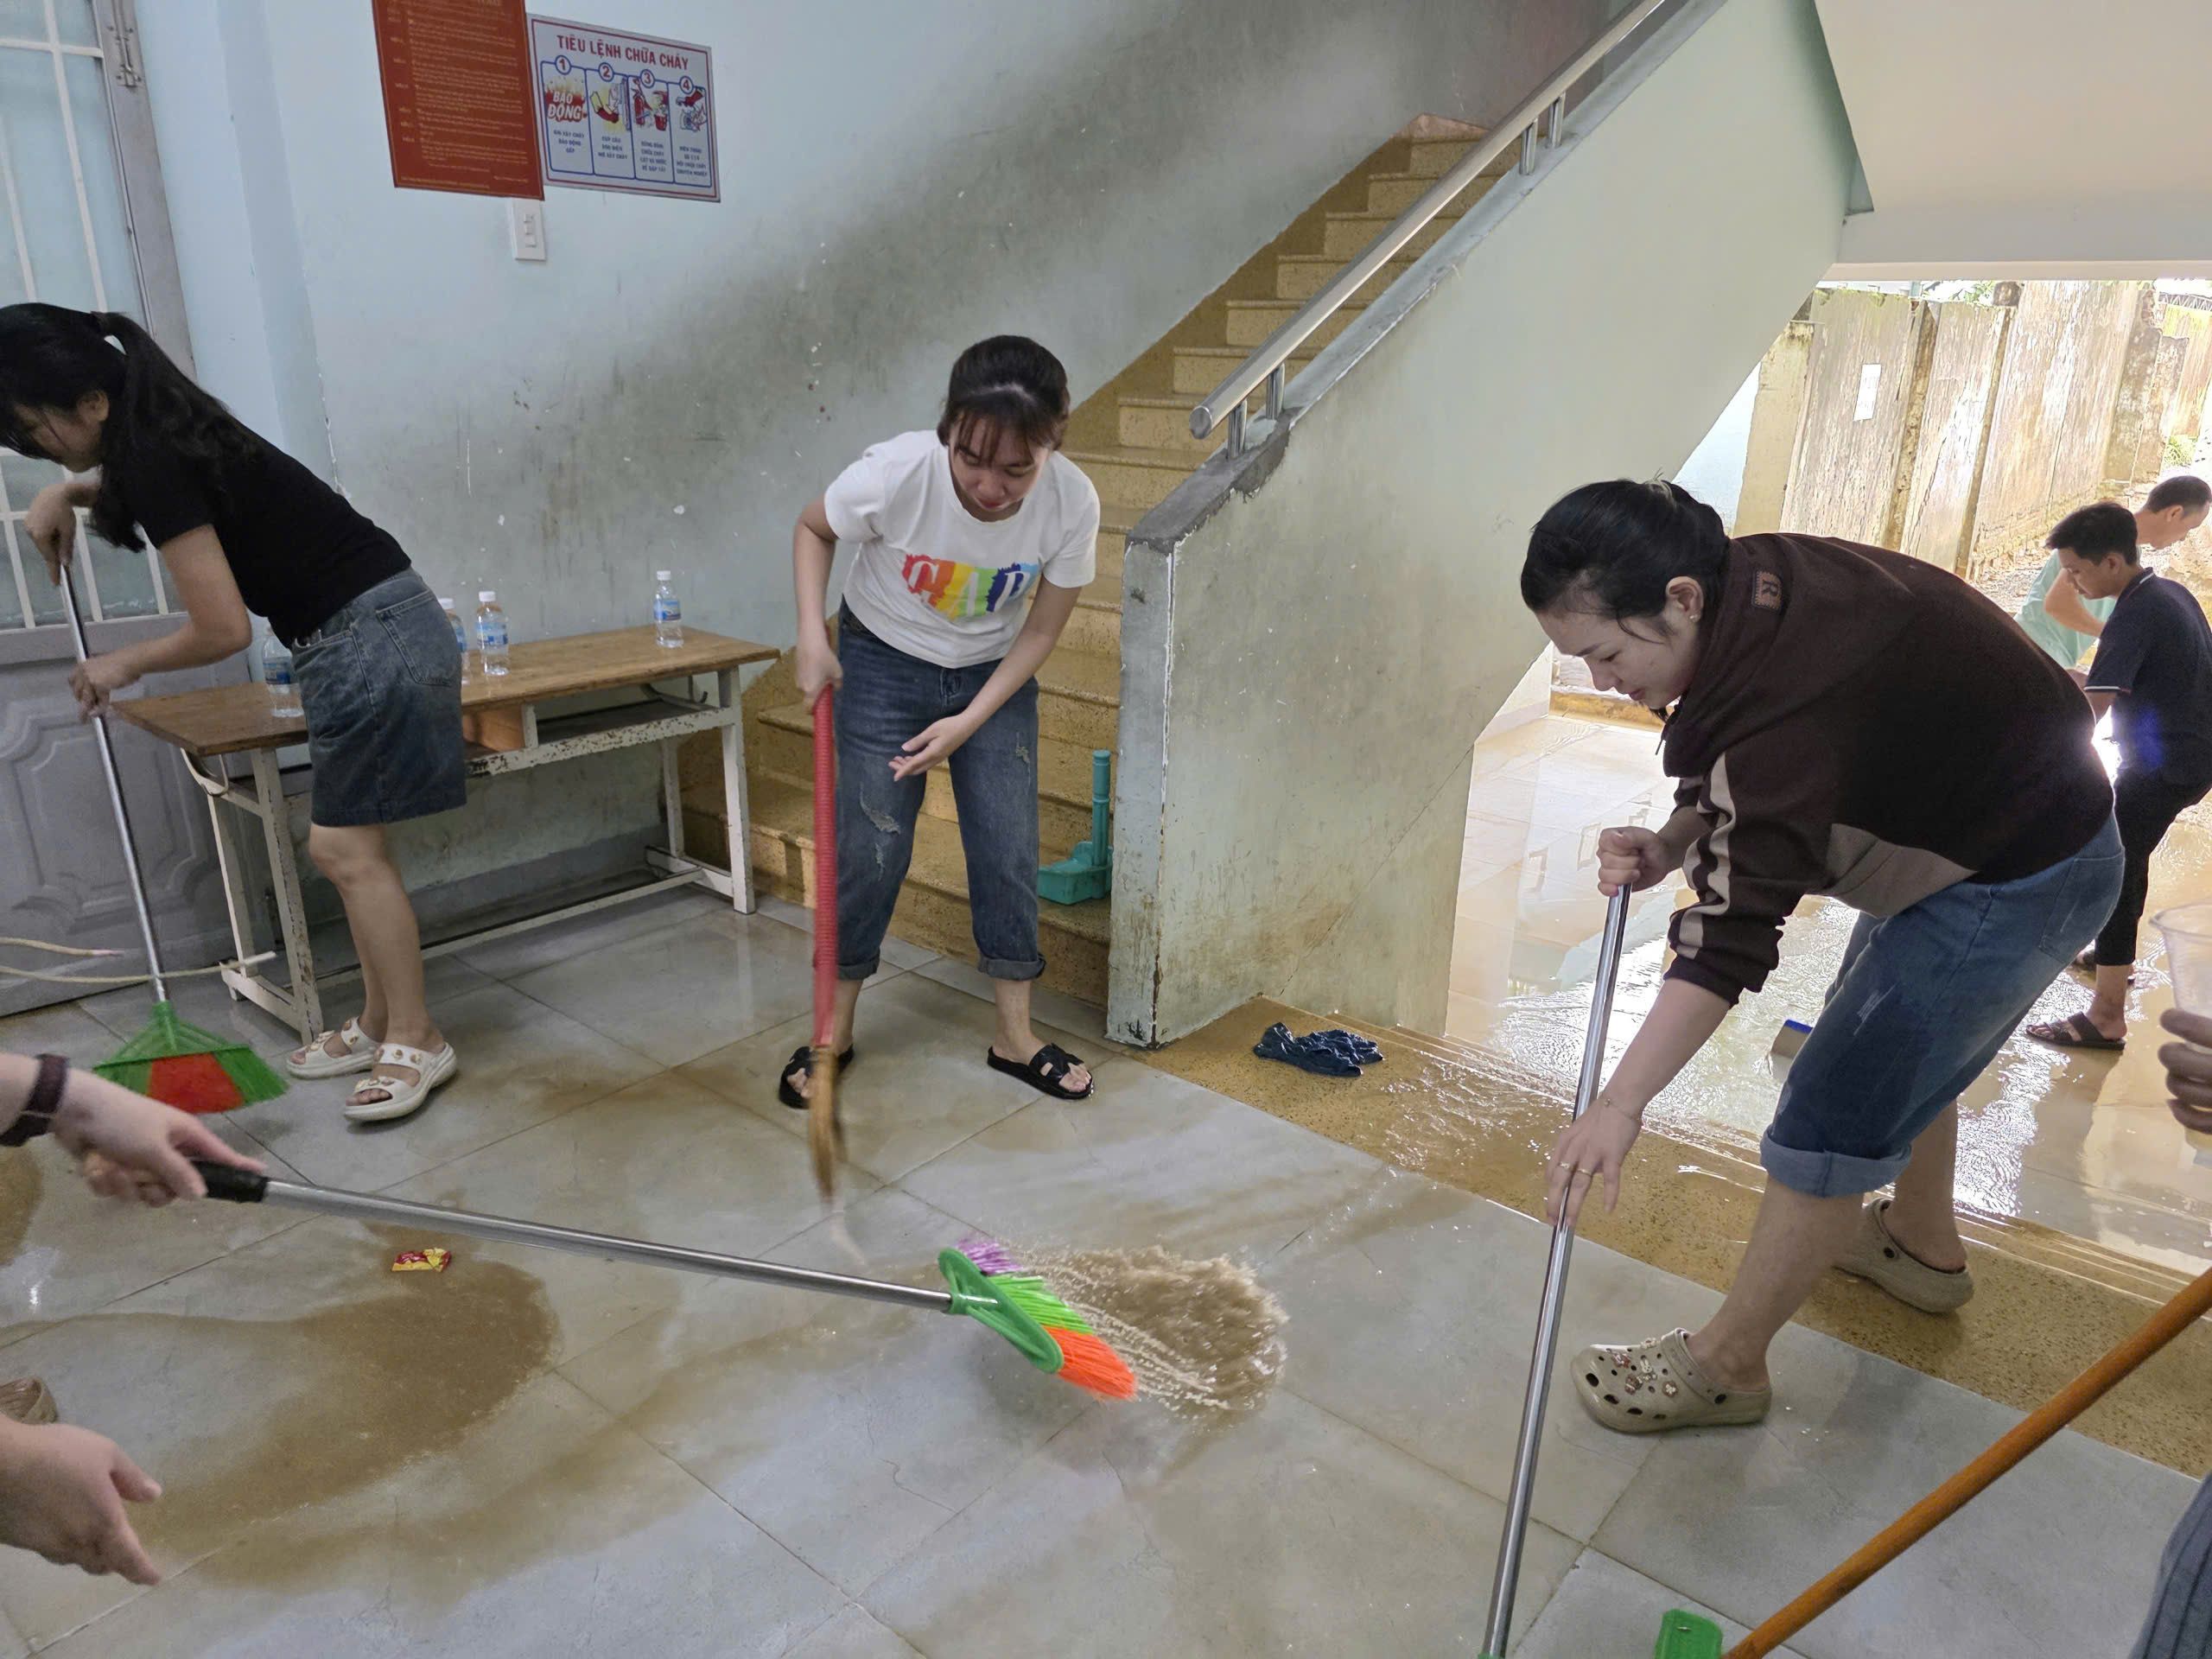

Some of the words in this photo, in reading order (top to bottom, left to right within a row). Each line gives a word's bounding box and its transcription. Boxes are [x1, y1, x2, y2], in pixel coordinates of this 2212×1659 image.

[559, 58, 566, 71] 1
[659, 54, 689, 70] CHÁY
[602, 65, 610, 78] 2
[644, 72, 652, 85] 3
[682, 79, 690, 91] 4
